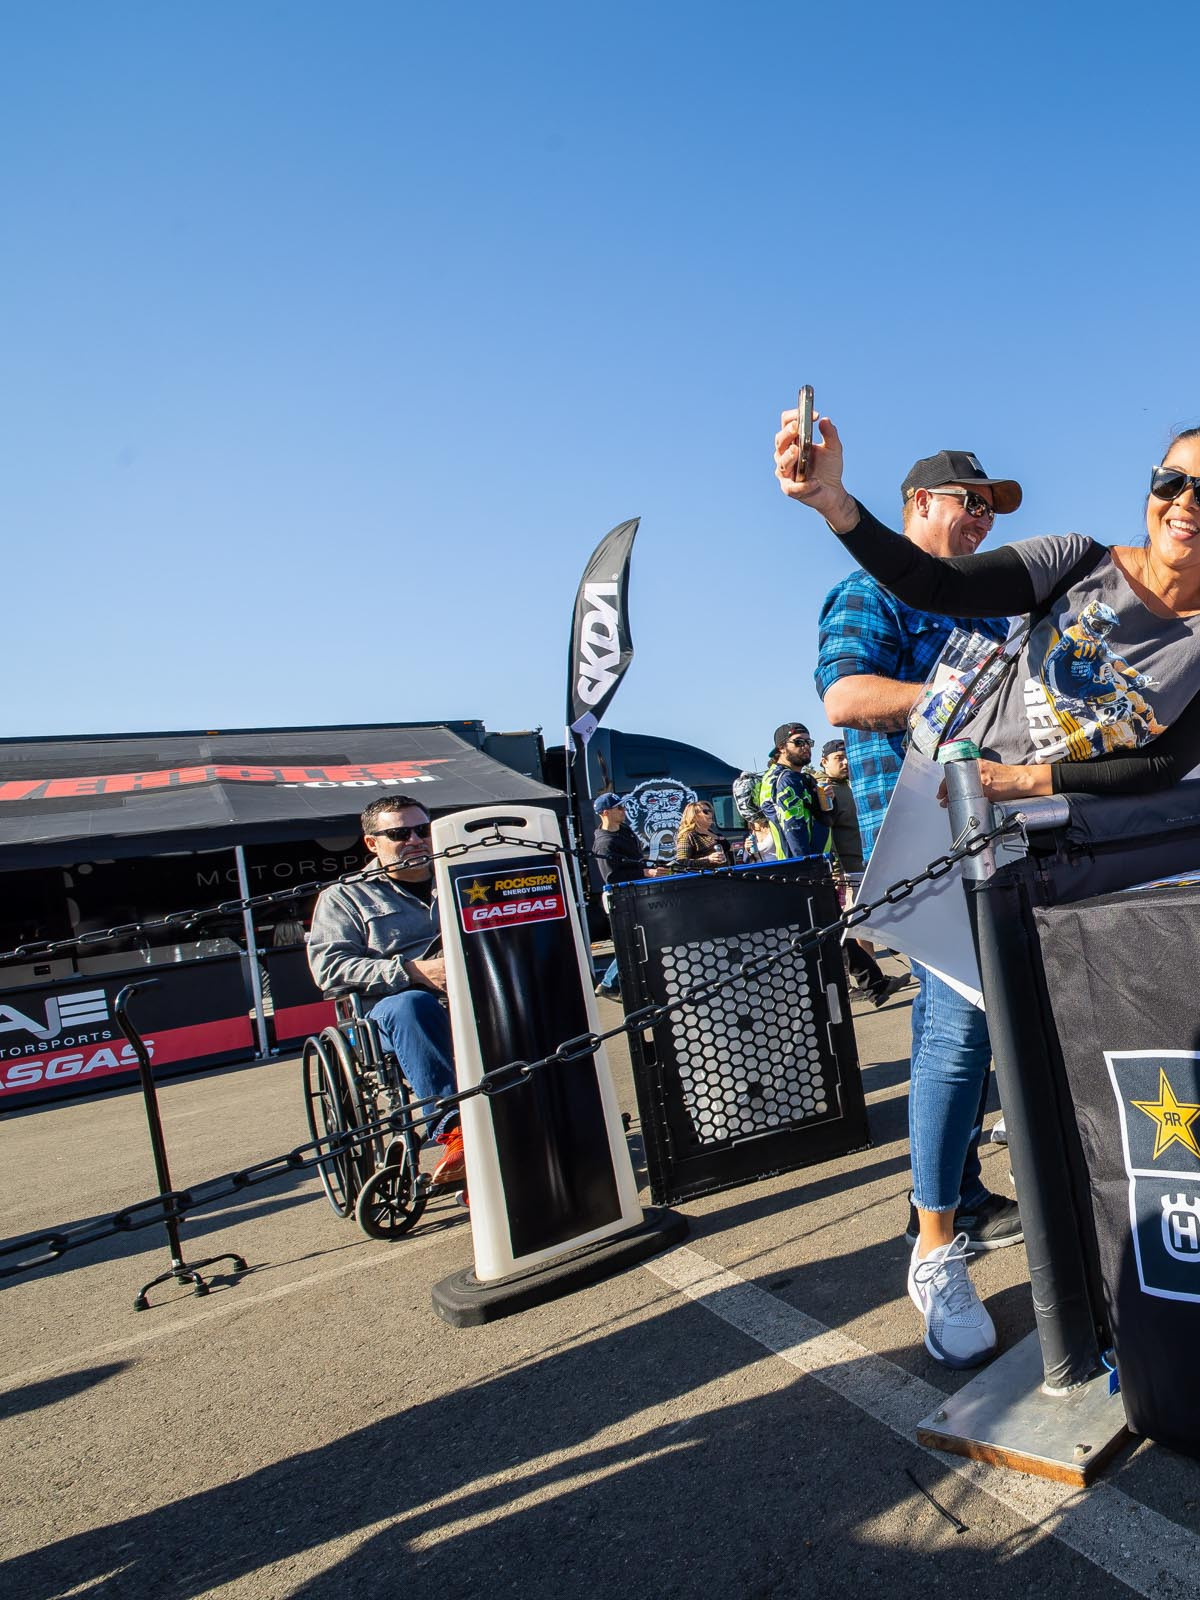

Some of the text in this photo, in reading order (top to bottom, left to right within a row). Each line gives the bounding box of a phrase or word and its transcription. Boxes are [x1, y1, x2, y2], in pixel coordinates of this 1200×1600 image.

[494, 874, 558, 891] ROCKSTAR
[502, 884, 553, 896] ENERGY DRINK
[472, 898, 557, 920] GASGAS
[0, 1040, 155, 1090] SGAS
